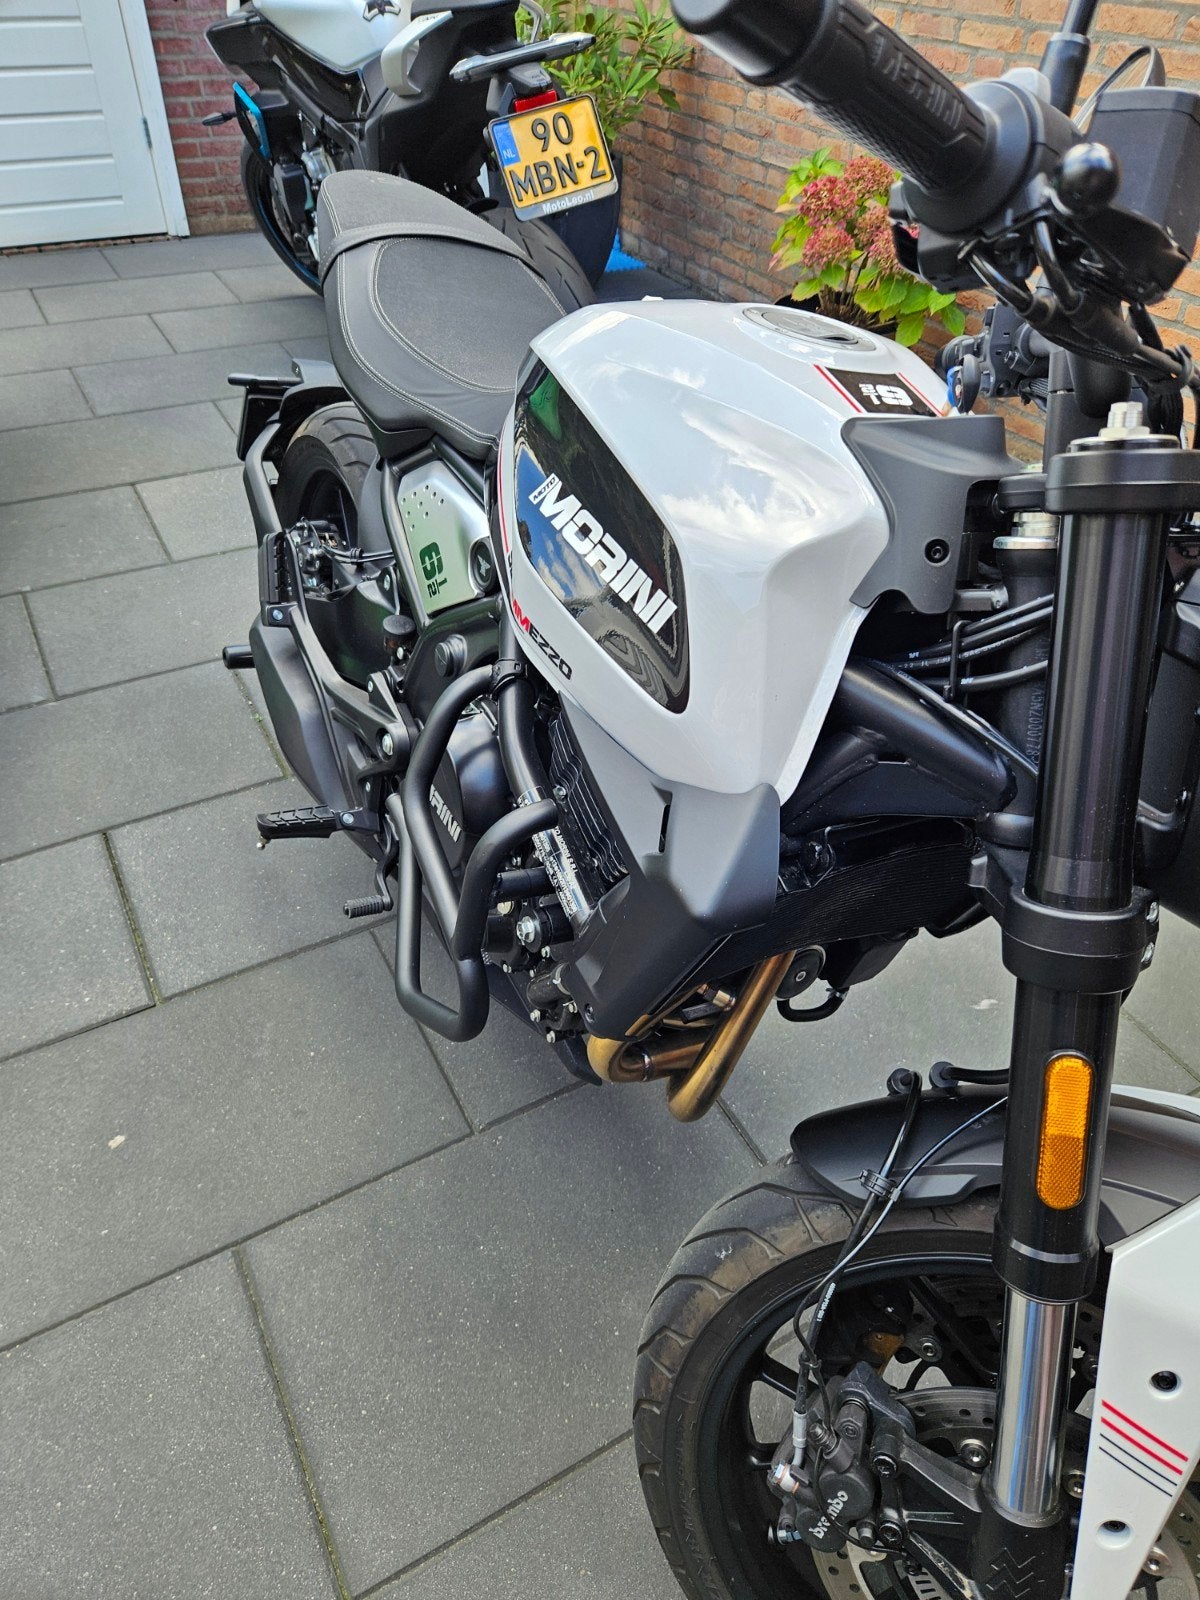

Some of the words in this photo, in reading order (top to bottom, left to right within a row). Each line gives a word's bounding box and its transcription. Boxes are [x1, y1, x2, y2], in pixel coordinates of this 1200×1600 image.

[531, 111, 574, 152] 90
[502, 148, 516, 160] NL
[509, 146, 607, 202] MBN-2
[533, 476, 556, 501] MOTO
[539, 480, 678, 634] MORINI
[556, 834, 572, 858] MORINI
